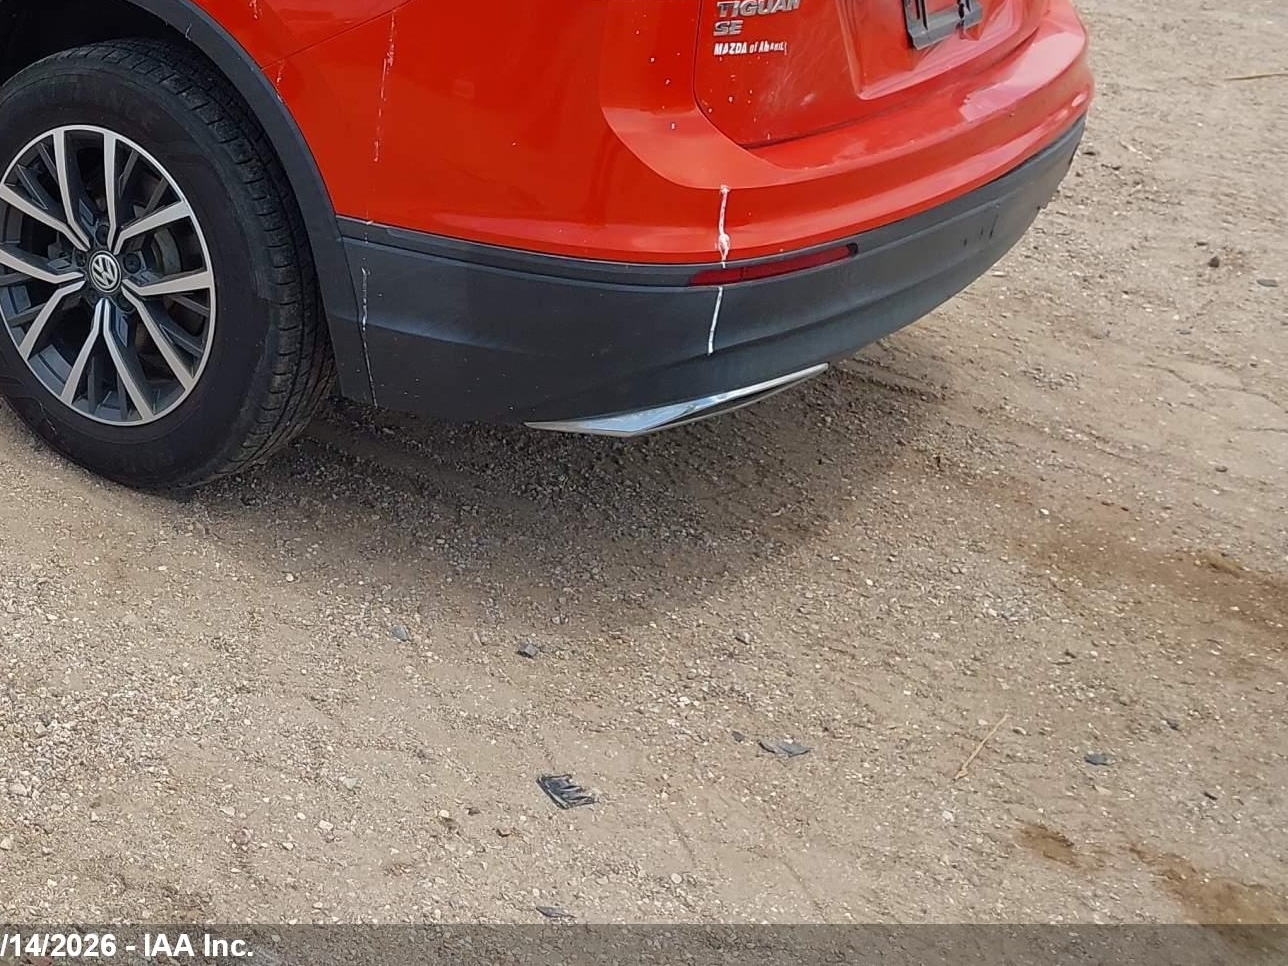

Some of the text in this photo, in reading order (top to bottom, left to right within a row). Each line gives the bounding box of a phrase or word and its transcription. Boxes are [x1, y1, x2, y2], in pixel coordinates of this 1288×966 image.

[713, 20, 744, 37] SE
[714, 41, 748, 56] MAZDA
[749, 42, 758, 54] of
